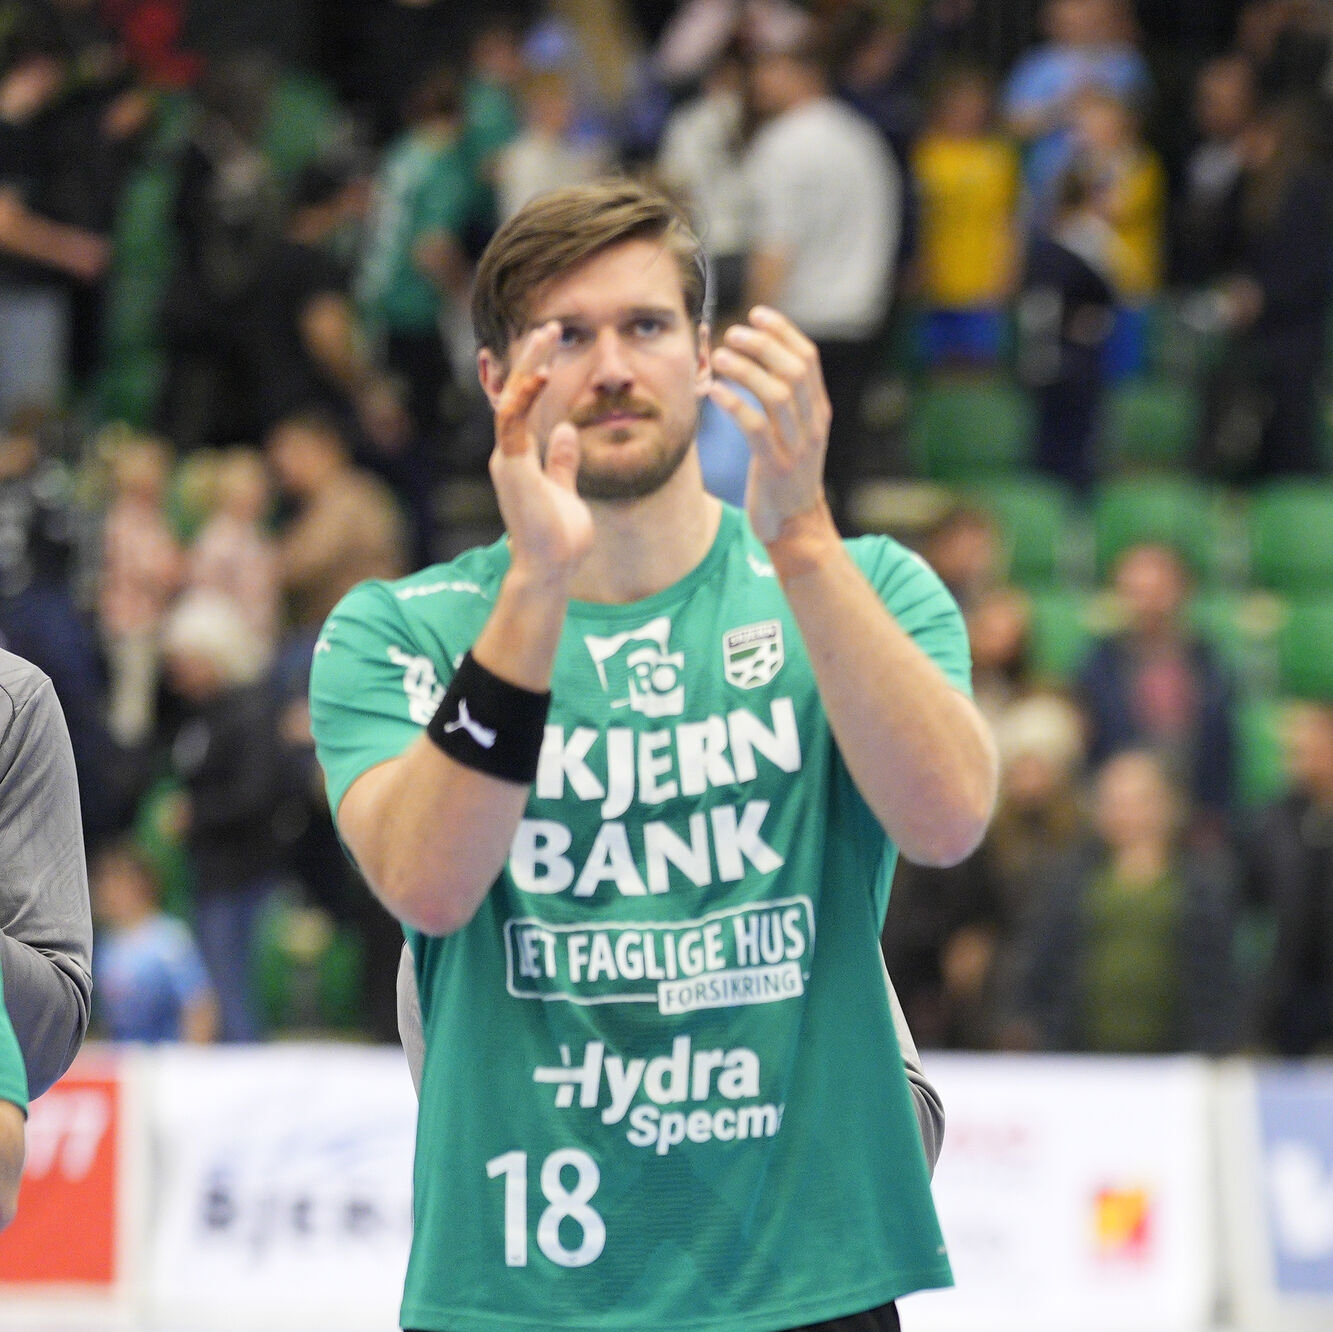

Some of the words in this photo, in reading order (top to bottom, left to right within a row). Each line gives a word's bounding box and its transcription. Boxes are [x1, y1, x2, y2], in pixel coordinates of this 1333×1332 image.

[535, 697, 801, 820] KJERN
[509, 800, 786, 897] BANK
[567, 922, 727, 984] FAGLIGE
[733, 907, 806, 967] HUS
[663, 969, 799, 1008] FORSIKRING
[532, 1035, 761, 1125] Hydra
[625, 1102, 786, 1155] Specm
[486, 1147, 607, 1268] 18
